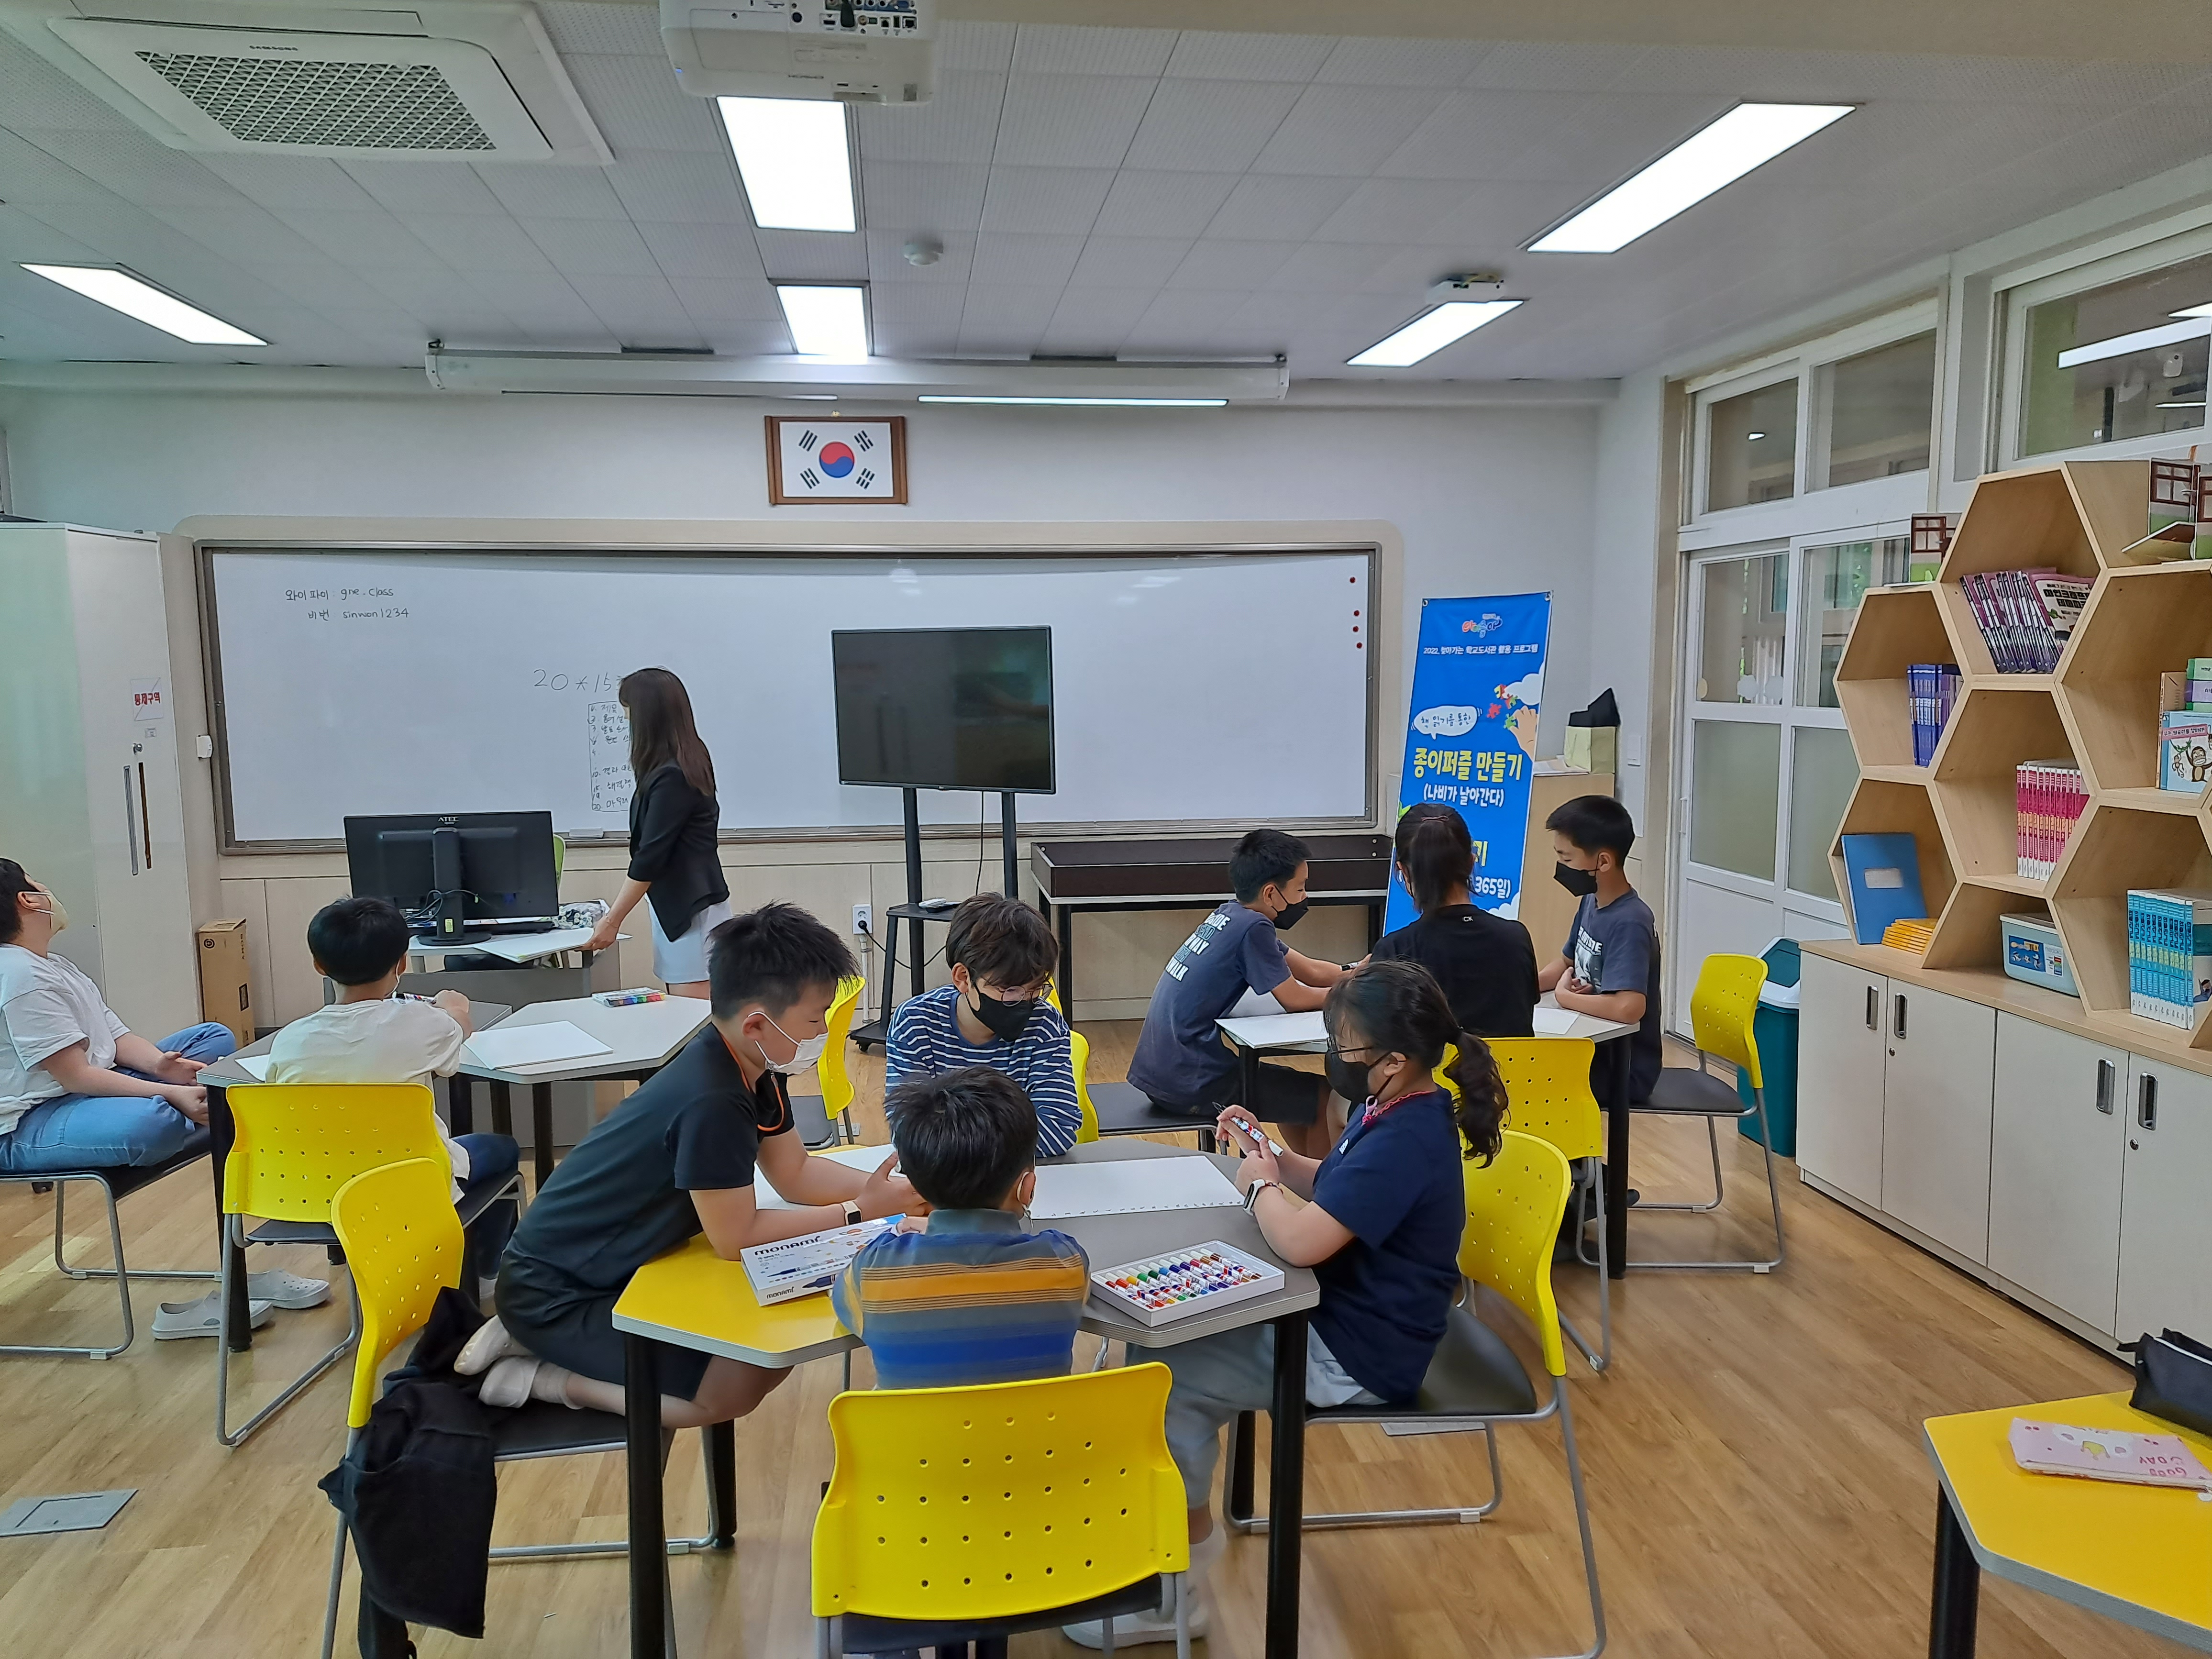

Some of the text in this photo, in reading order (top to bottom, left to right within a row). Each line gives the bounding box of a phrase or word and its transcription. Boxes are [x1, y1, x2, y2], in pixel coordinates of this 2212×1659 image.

[308, 609, 329, 621] 비번
[1466, 645, 1496, 654] 학교도서관
[1513, 644, 1538, 653] 프로그램
[1421, 713, 1471, 729] 책 읽기를 통한
[1414, 747, 1523, 783] 종이퍼즐 만들기
[1423, 783, 1504, 807] (나비가 날아간다)
[1475, 876, 1512, 899] 365일)
